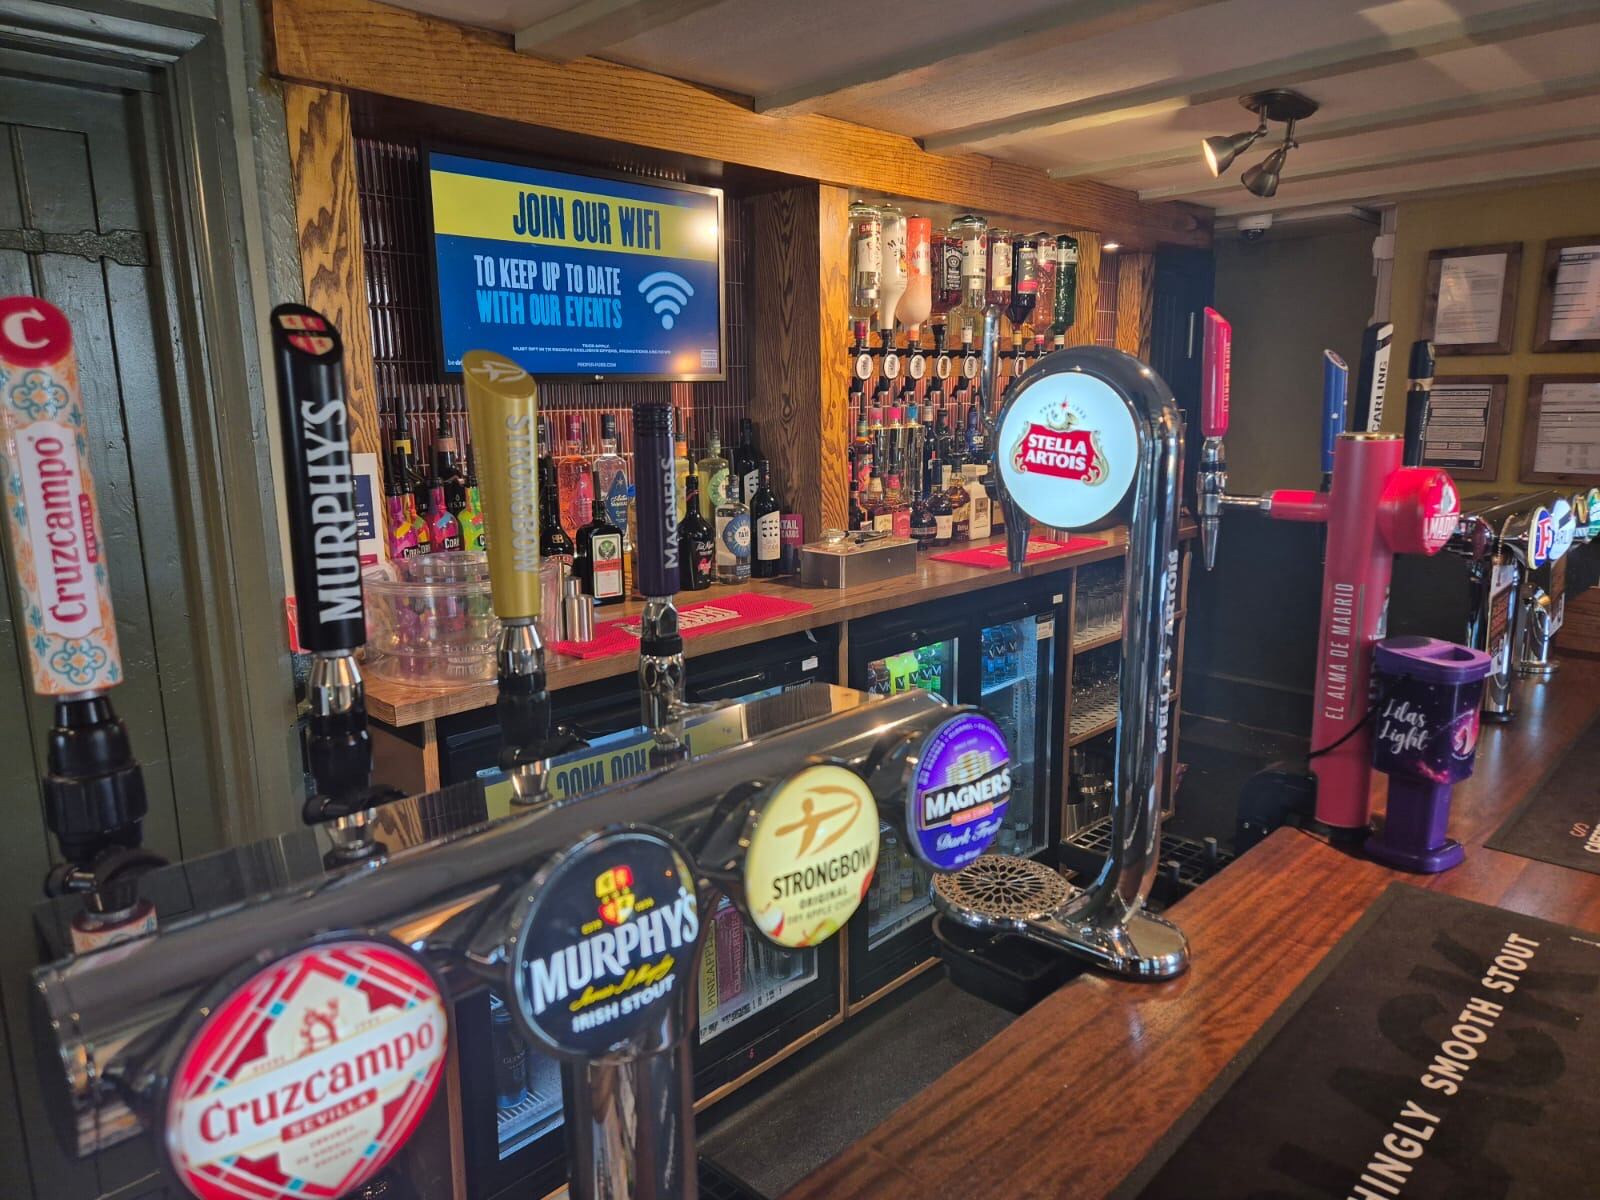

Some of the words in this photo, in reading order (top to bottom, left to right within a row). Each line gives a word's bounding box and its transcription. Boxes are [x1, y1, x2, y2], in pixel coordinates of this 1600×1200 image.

[512, 191, 566, 240] JOIN
[571, 199, 612, 245] OUR
[617, 205, 661, 250] WIFI
[474, 254, 496, 287] TO
[499, 257, 538, 291] KEEP
[541, 261, 560, 293] UP
[565, 263, 583, 294] TO
[587, 265, 622, 296] DATE
[2, 308, 50, 350] C
[475, 289, 525, 326] WITH
[529, 293, 562, 327] OUR
[565, 297, 623, 329] EVENTS
[1372, 361, 1389, 433] CARLING
[1025, 450, 1087, 471] ARTOIS
[1028, 433, 1087, 456] STELLA
[300, 399, 363, 624] MURPHY'S
[506, 415, 541, 573] STRONGBOW
[659, 455, 680, 570] MAGNERS
[34, 435, 89, 624] Cruzcampo
[1332, 582, 1355, 638] MADRID
[1330, 640, 1349, 659] DE
[1328, 662, 1348, 702] ALMA
[1325, 704, 1344, 721] EL
[1379, 720, 1430, 755] Light
[924, 767, 1012, 820] MAGNERS
[935, 827, 972, 852] Dark
[772, 842, 874, 901] STRONGBOW
[800, 884, 848, 910] ORIGINAL
[529, 885, 699, 1016] MURPHY'S
[572, 1001, 620, 1034] IRISH
[621, 973, 677, 1016] STOUT
[1420, 997, 1504, 1096] SMOOTH
[1481, 933, 1540, 994] STOUT
[197, 1021, 436, 1143] Cruzcampo
[289, 1093, 372, 1139] SEVILLA
